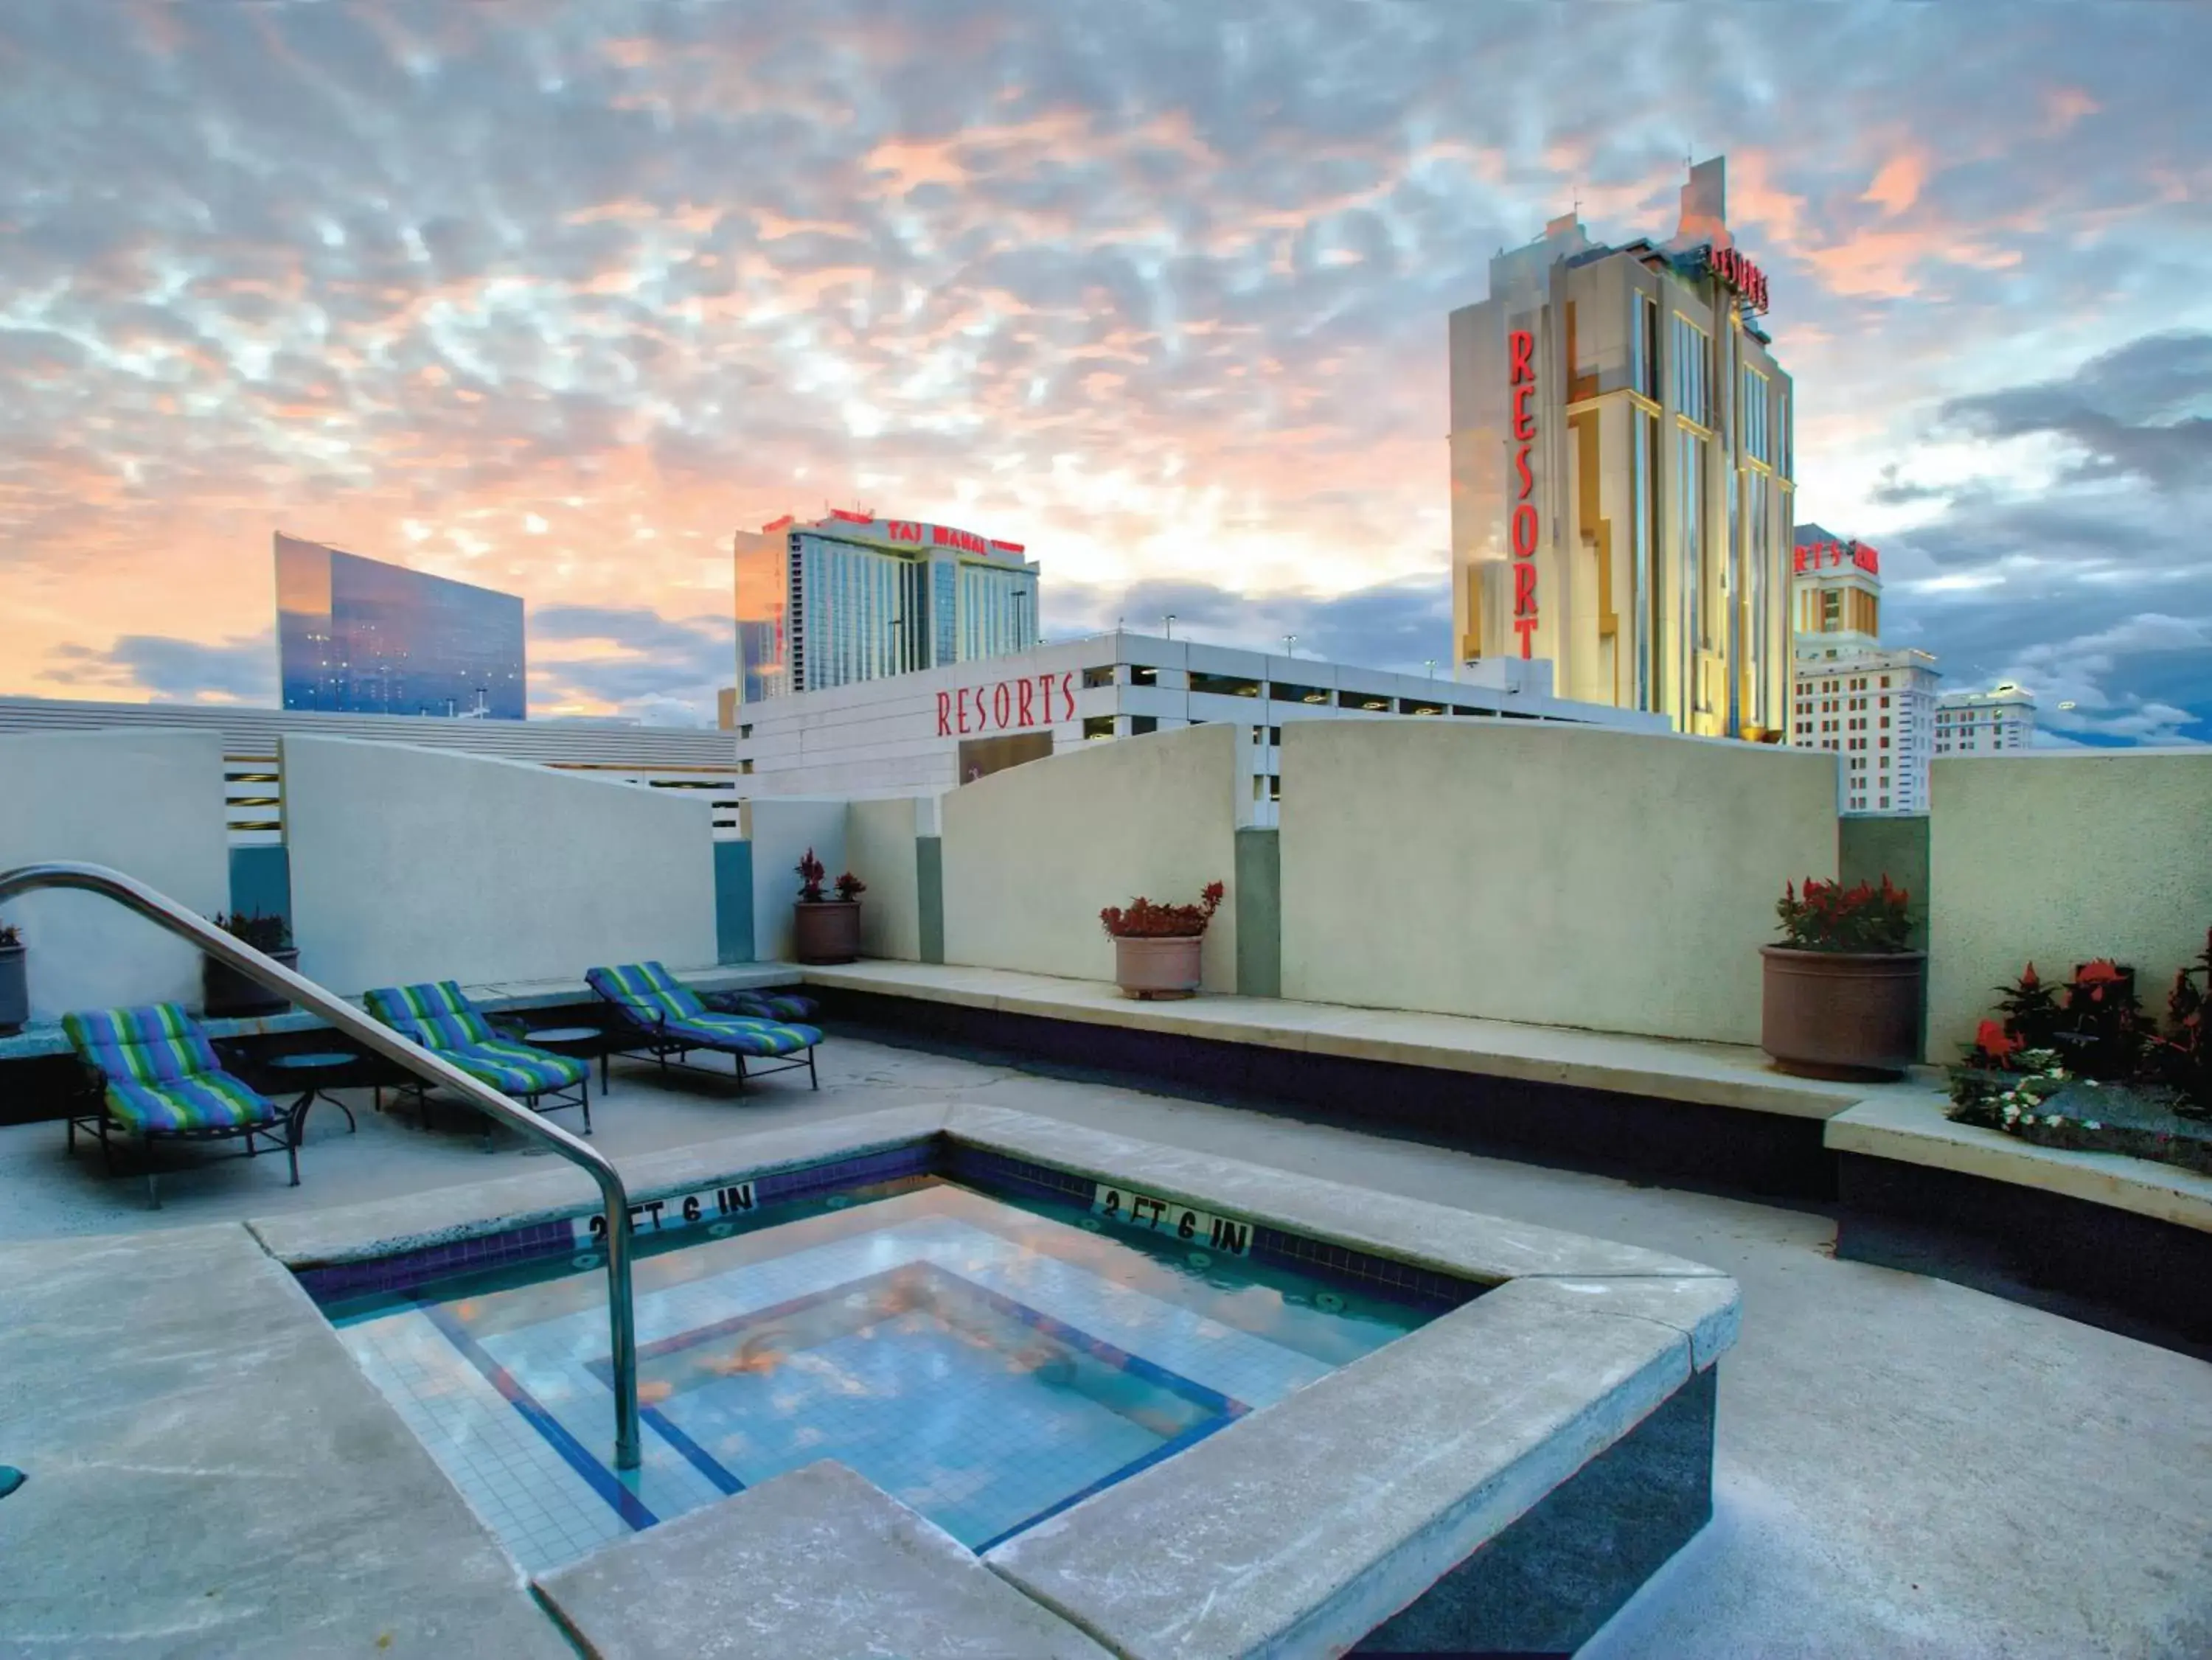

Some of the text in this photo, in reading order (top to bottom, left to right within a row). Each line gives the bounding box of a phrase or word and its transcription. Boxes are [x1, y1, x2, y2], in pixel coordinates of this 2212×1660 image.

[888, 520, 923, 543] TAJ
[933, 526, 988, 556] MAHAL
[936, 672, 1077, 736] RESORTS
[627, 1202, 663, 1235] FT
[683, 1196, 700, 1221] 6
[717, 1185, 752, 1215] IN
[1104, 1190, 1248, 1255] 2 FT 6 IN
